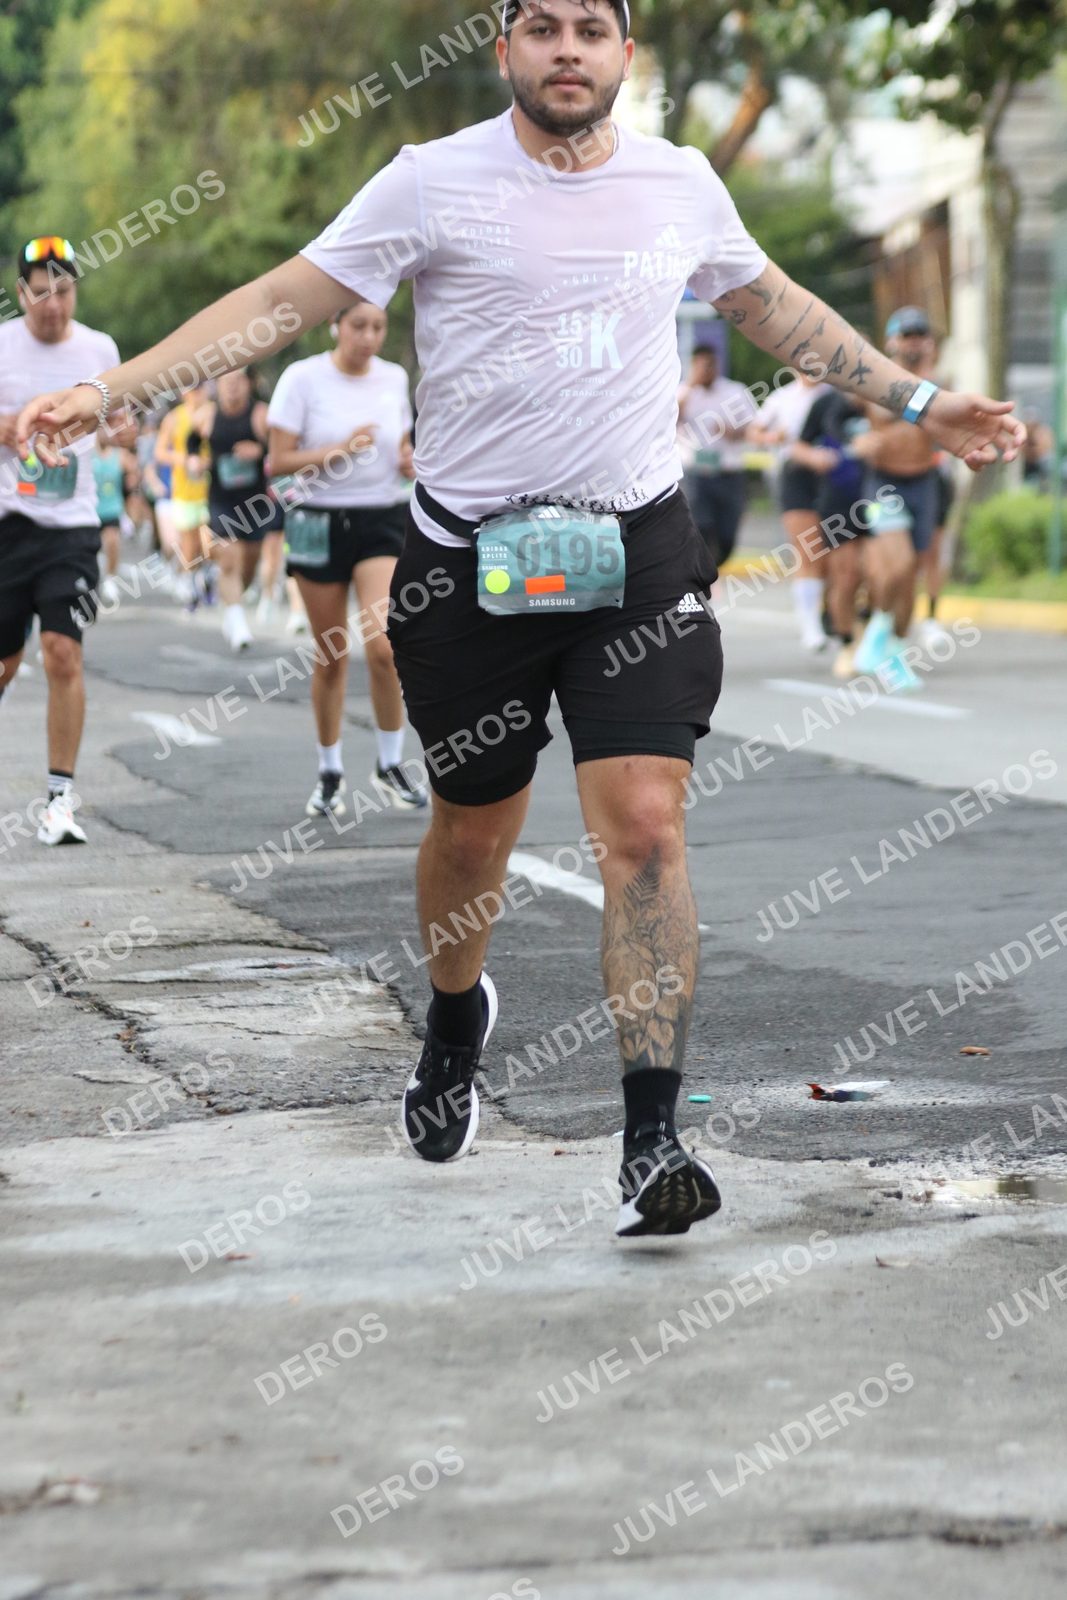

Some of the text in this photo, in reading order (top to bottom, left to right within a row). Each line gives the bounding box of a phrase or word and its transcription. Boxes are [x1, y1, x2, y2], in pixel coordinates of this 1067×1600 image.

[557, 312, 584, 335] 15
[590, 313, 624, 369] K
[556, 346, 583, 368] 30
[516, 531, 620, 577] 0195
[528, 598, 576, 607] SAMSUNG
